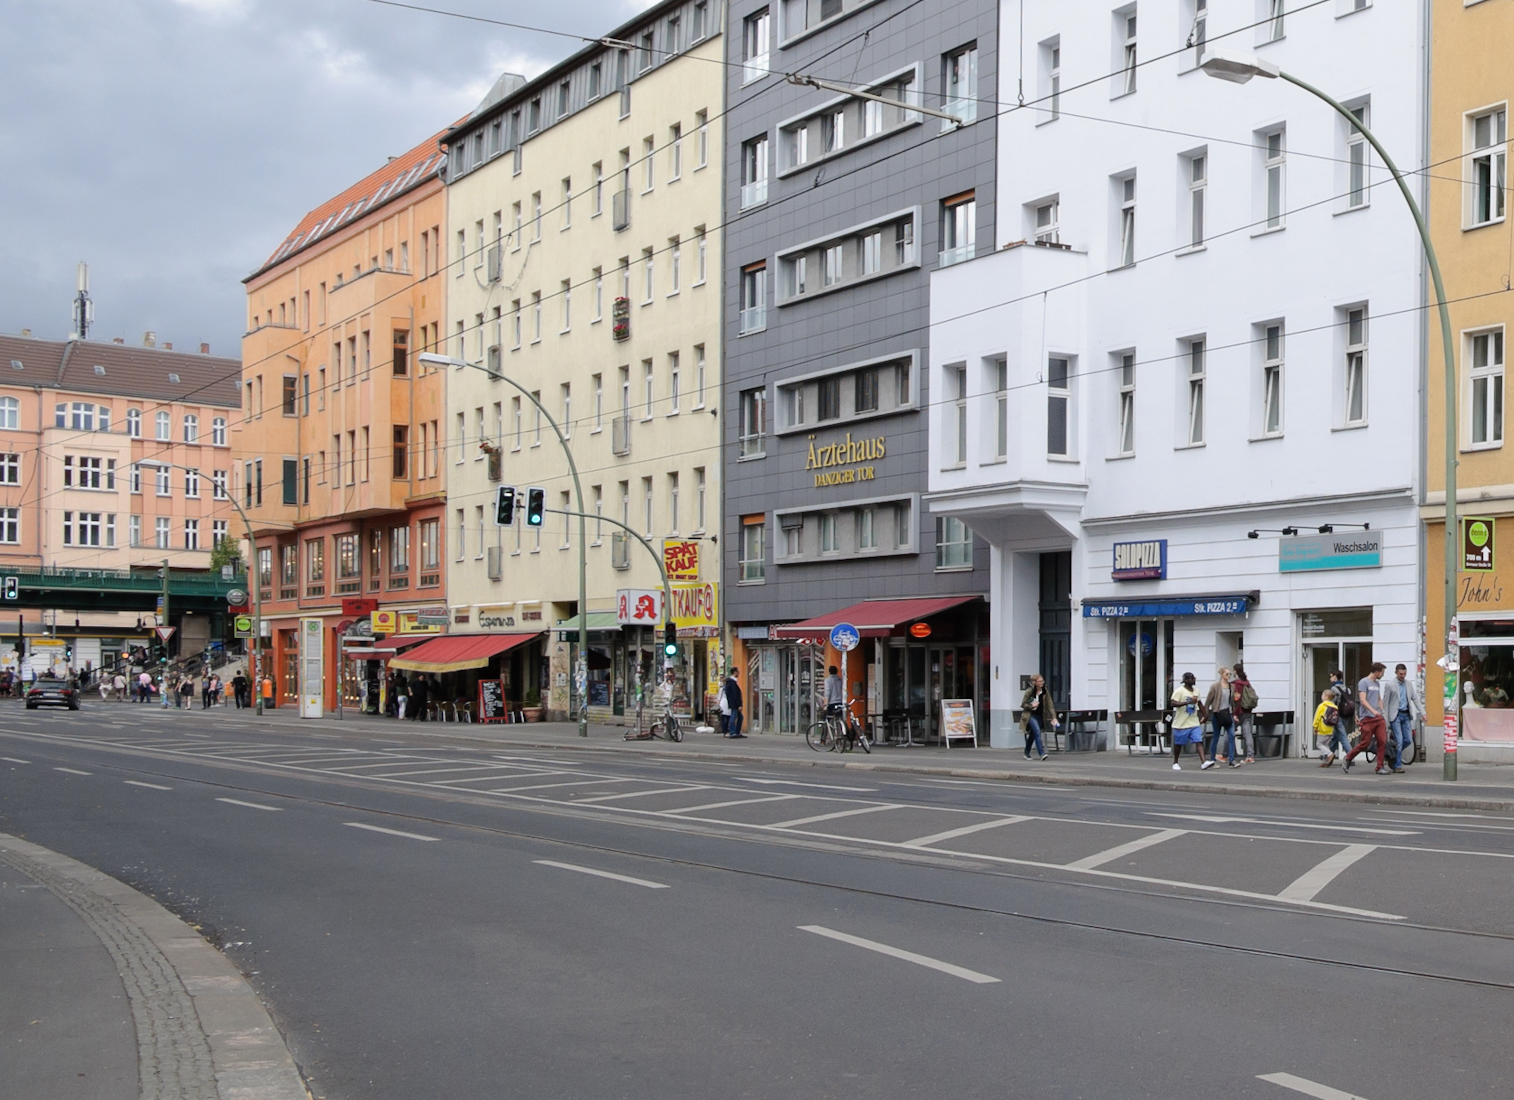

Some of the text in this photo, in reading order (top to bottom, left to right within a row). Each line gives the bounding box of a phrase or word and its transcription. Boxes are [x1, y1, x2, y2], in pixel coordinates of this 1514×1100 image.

[805, 433, 885, 470] Ärztehaus
[814, 466, 875, 487] DANZIGER TOR
[664, 541, 698, 560] SPÄT
[1333, 541, 1378, 553] Waschsalon
[665, 556, 698, 573] KAUF
[1457, 571, 1502, 608] John's
[633, 594, 657, 620] A
[1101, 606, 1118, 616] PIZZA
[1207, 602, 1226, 613] PIZZA
